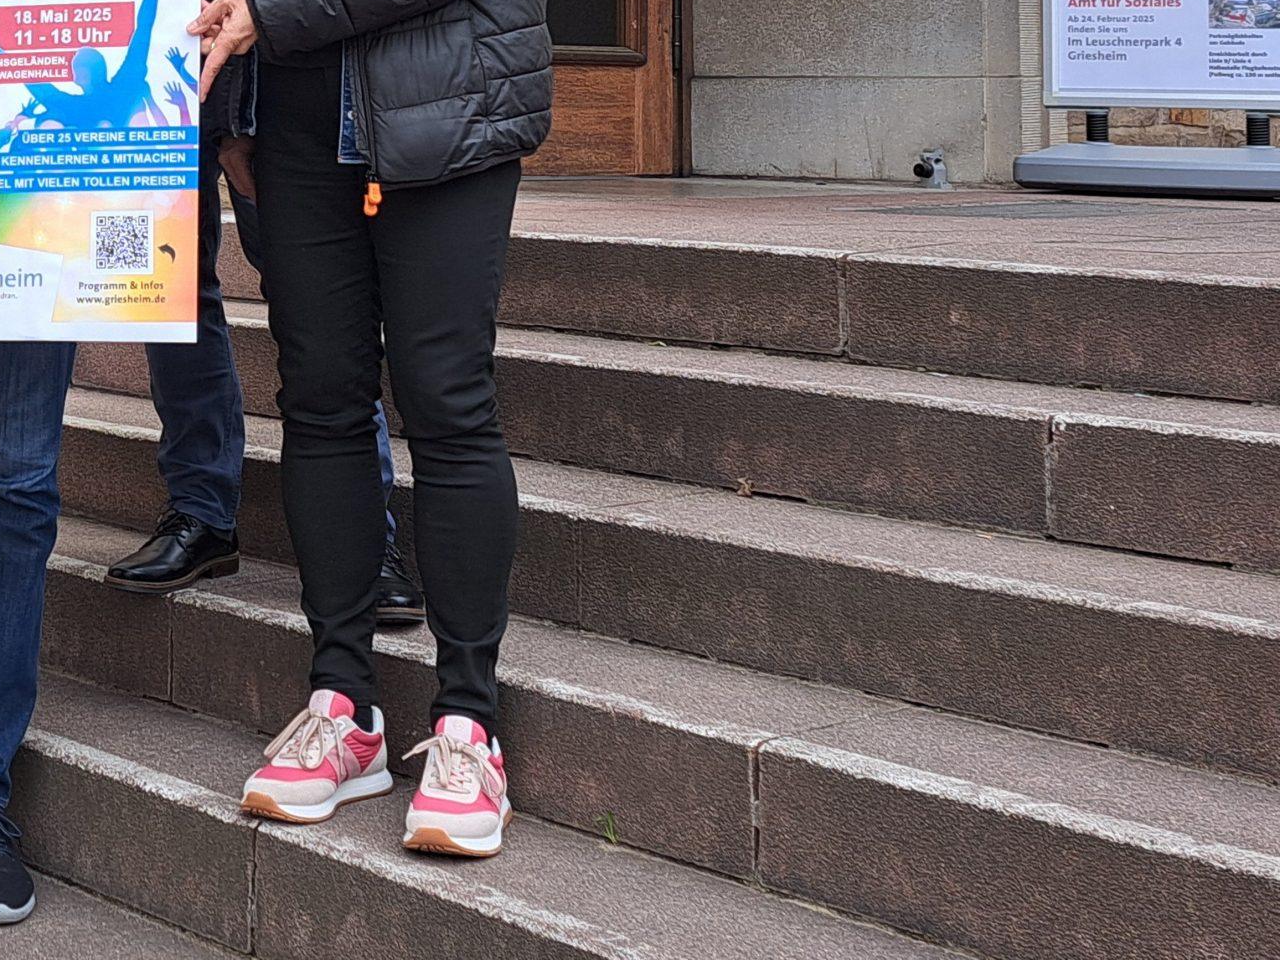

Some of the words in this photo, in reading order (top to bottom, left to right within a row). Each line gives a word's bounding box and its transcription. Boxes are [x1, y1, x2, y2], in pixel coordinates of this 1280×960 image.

[14, 11, 37, 24] 18.
[40, 9, 68, 23] Mai
[74, 8, 112, 22] 2025
[1068, 15, 1079, 23] Ab
[1081, 15, 1095, 23] 24.
[1097, 15, 1130, 23] Februar
[1132, 15, 1155, 23] 2025
[1067, 25, 1095, 33] finden
[1098, 25, 1110, 33] Sie
[14, 30, 33, 45] 11
[51, 29, 71, 44] 18
[78, 27, 112, 43] Uhr
[1067, 37, 1082, 46] Im
[1086, 36, 1172, 49] Leuschnerpark
[1174, 37, 1182, 46] 4
[1067, 50, 1127, 61] Griesheim
[22, 130, 54, 144] ÜBER
[58, 132, 71, 143] 25
[74, 132, 126, 143] VEREINE
[129, 131, 186, 141] ERLEBEN
[1, 155, 99, 166] KENNENLERNEN
[102, 154, 109, 164] &
[113, 153, 186, 163] MITMACHEN
[14, 177, 34, 188] MIT
[37, 177, 79, 188] VIELEN
[83, 176, 130, 187] TOLLEN
[133, 175, 186, 186] PREISEN
[78, 281, 127, 292] Programm
[130, 281, 138, 290] &
[140, 280, 164, 290] Infos
[1, 292, 18, 300] dran.
[76, 294, 166, 305] www.griesheim.de
